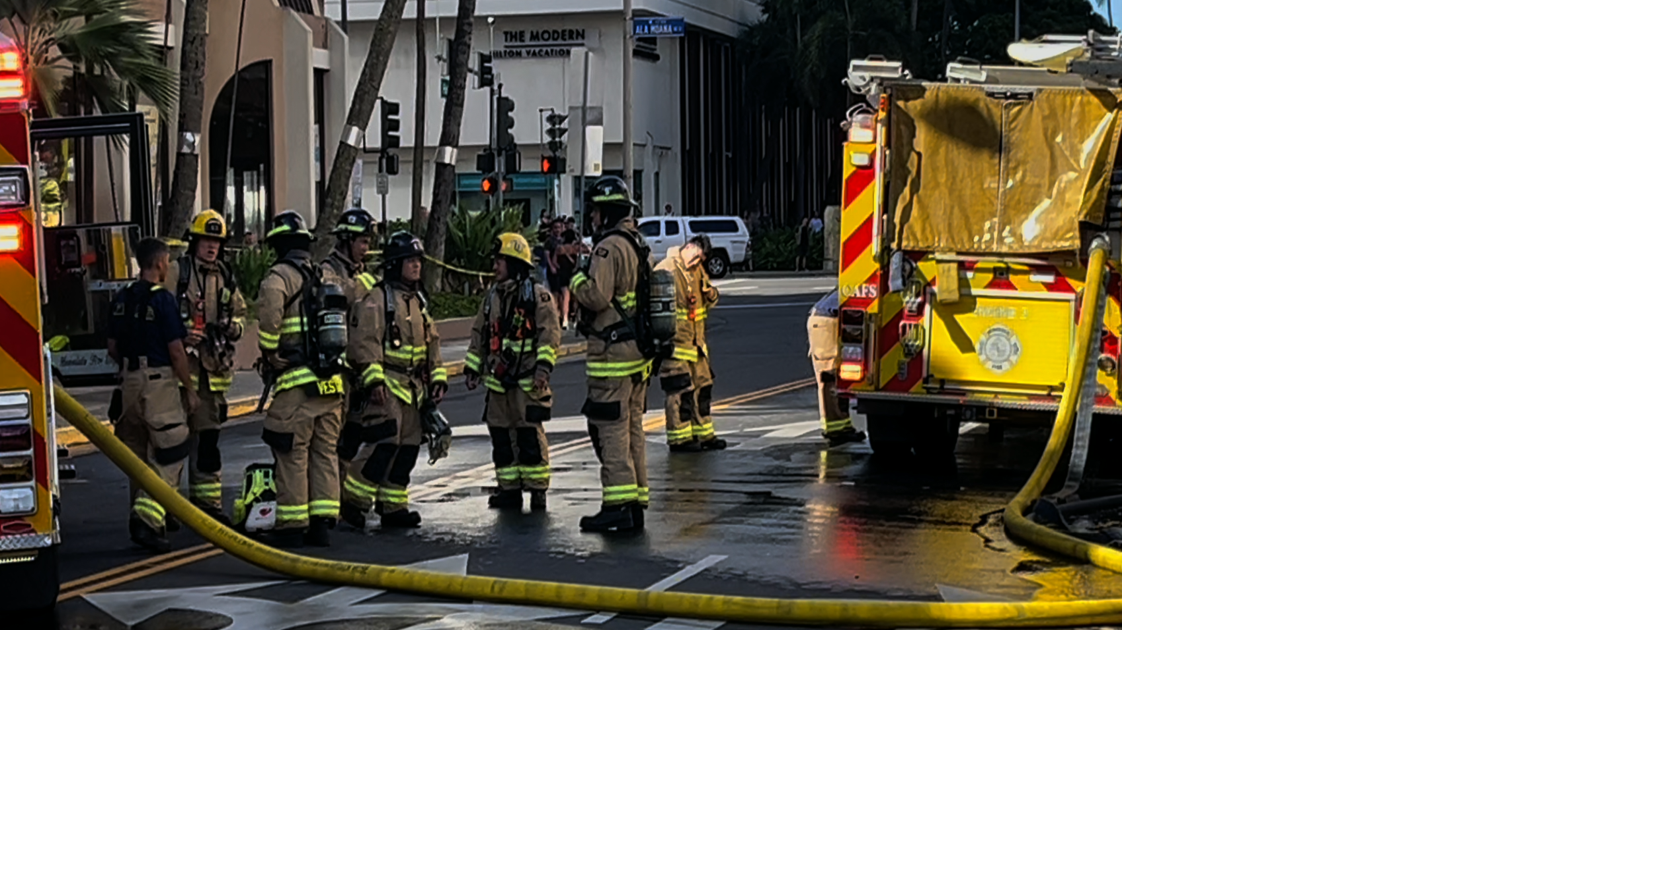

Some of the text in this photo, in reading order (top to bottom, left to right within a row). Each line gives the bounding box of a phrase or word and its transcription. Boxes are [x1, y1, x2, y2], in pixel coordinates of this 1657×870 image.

[635, 25, 649, 34] ALA
[503, 29, 585, 43] THE MODERN
[525, 48, 571, 57] VACATION
[841, 284, 878, 299] CAFS
